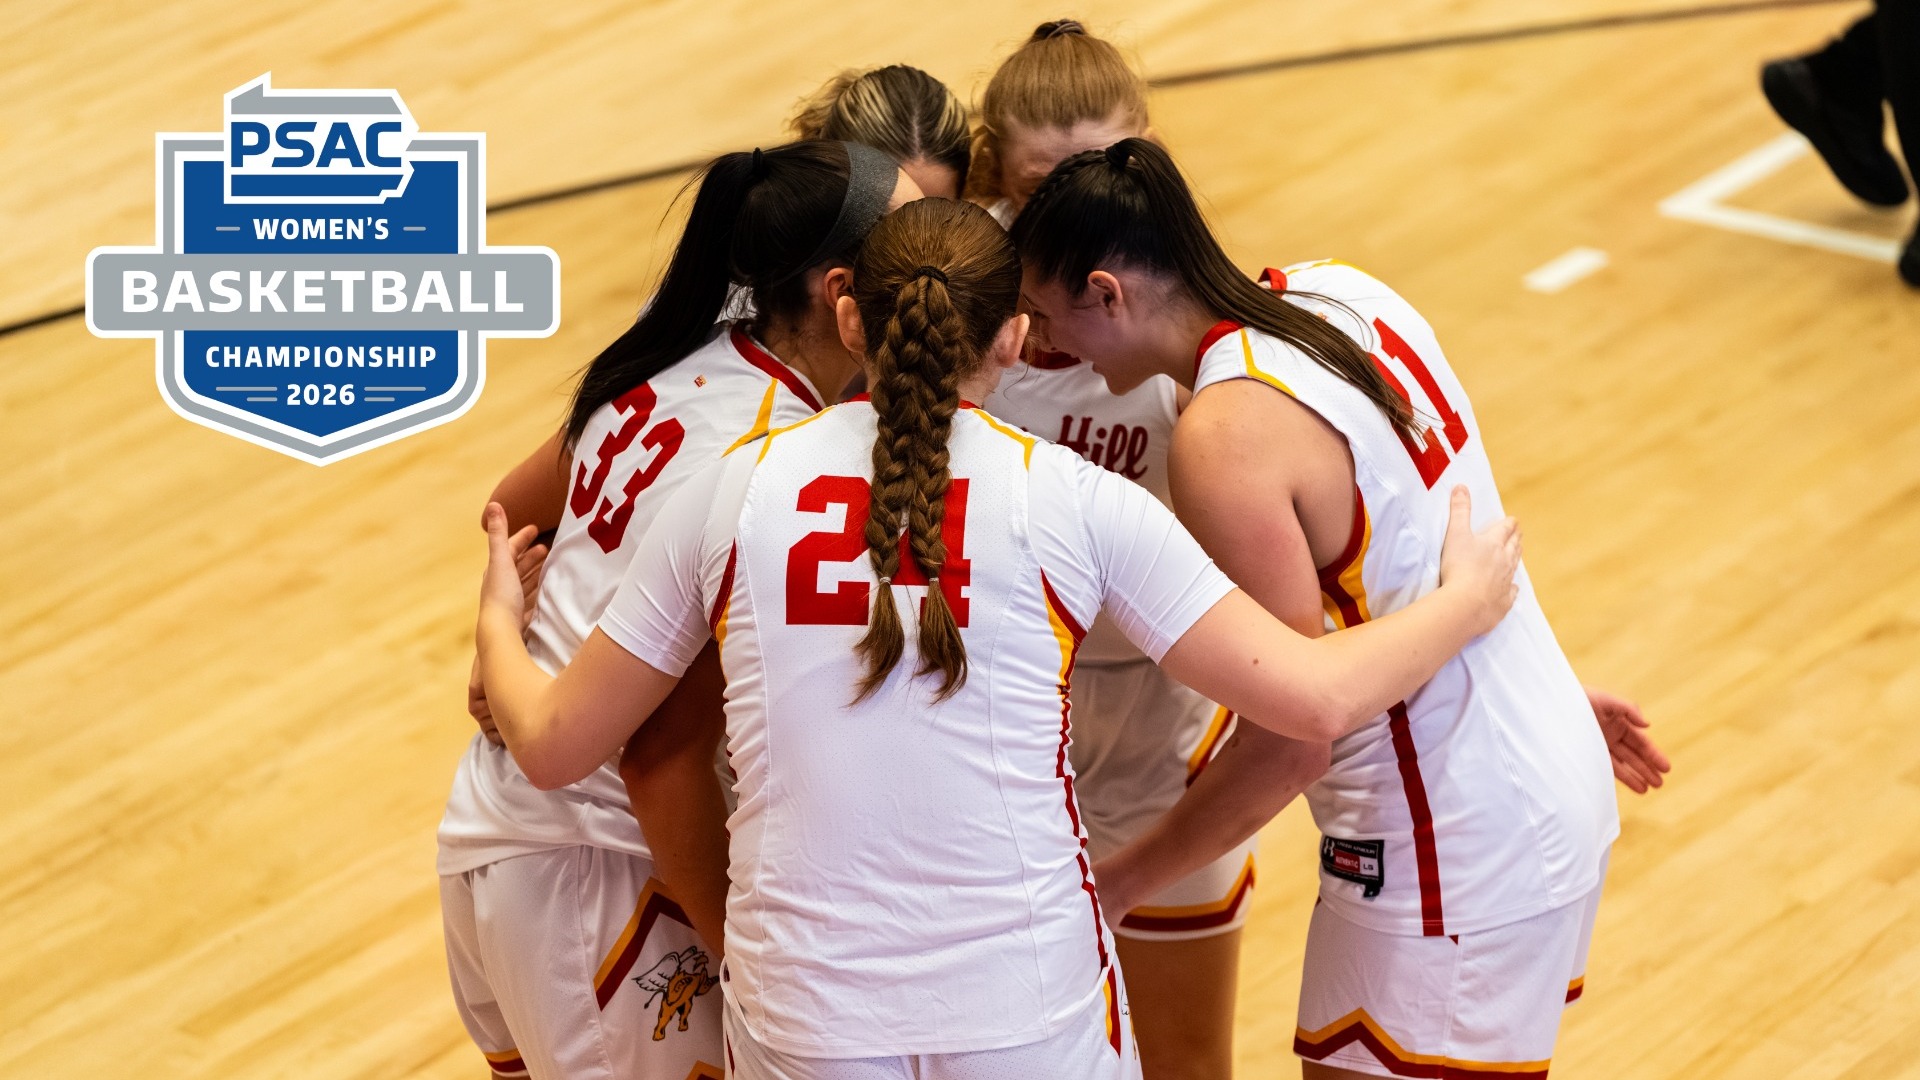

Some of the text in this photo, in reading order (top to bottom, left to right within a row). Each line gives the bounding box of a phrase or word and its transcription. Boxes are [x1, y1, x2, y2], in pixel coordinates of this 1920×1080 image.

[569, 380, 685, 555] 33
[1056, 414, 1148, 480] Hill
[786, 474, 971, 628] 24
